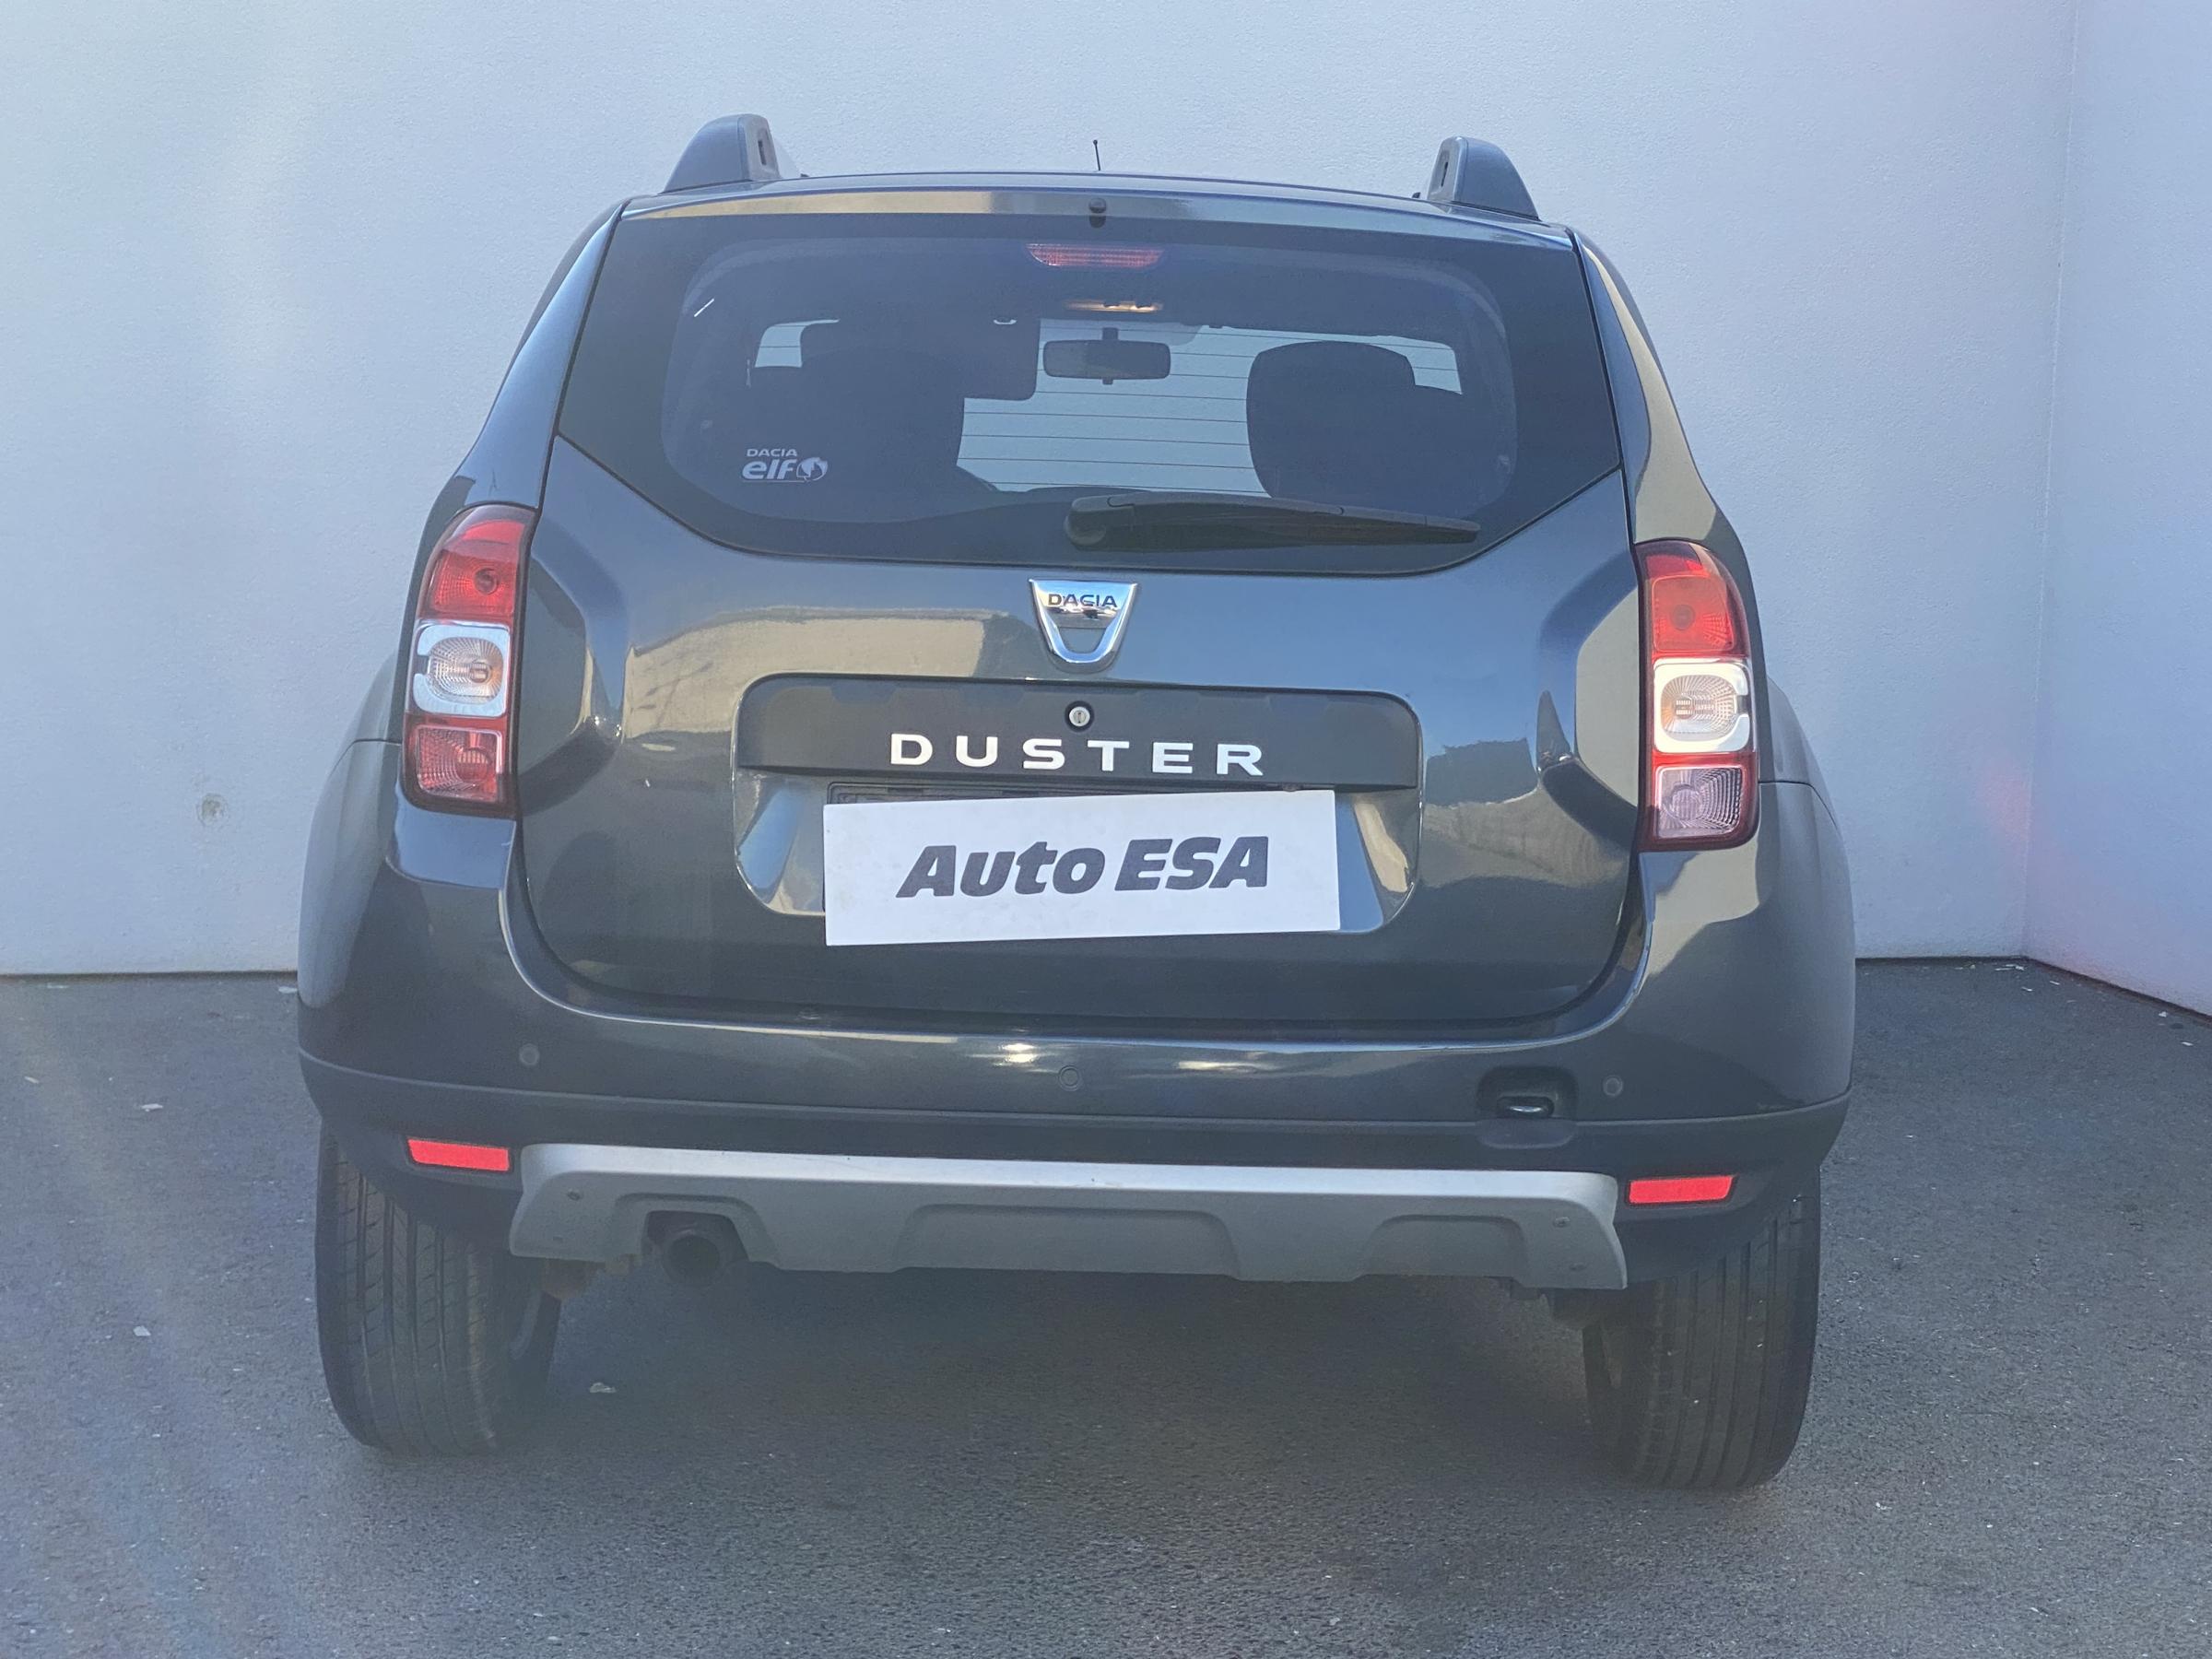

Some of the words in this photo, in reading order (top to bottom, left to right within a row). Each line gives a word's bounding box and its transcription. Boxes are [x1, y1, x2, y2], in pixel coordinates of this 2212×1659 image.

[746, 448, 798, 457] DACIA
[742, 459, 798, 480] elf
[1048, 594, 1118, 608] DACIA
[890, 732, 1265, 777] DUSTER
[895, 841, 1106, 899] Auto
[1114, 836, 1270, 892] ESA
